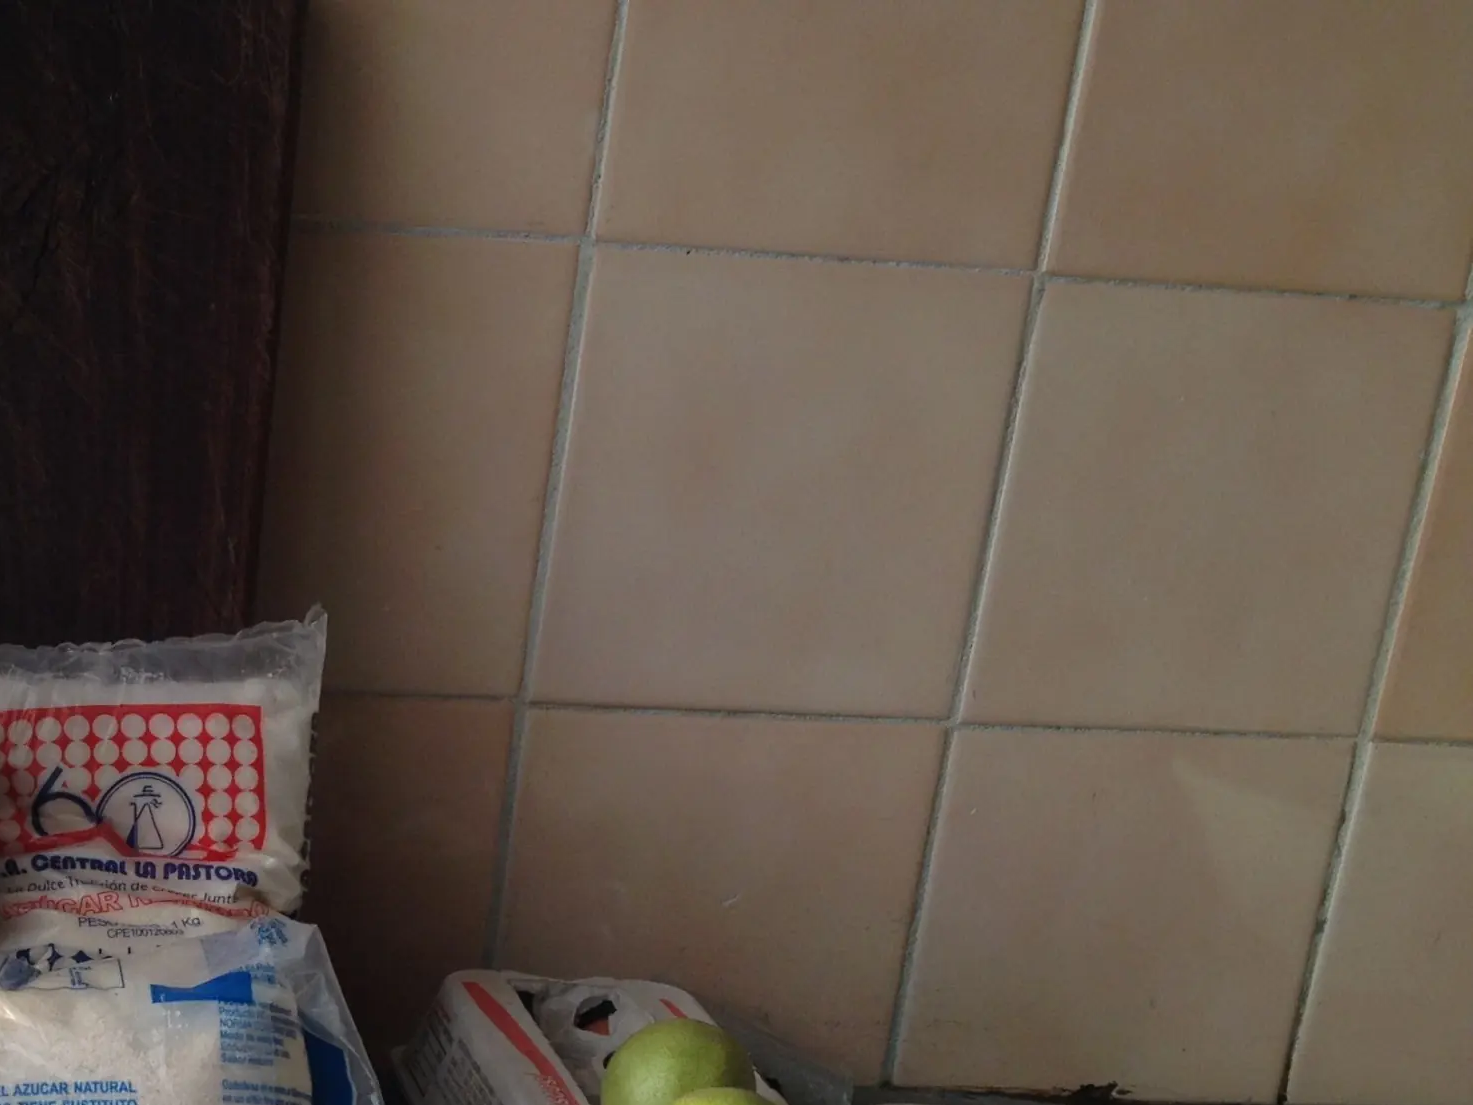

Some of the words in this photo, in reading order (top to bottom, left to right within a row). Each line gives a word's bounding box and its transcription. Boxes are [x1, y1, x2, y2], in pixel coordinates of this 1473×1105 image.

[31, 854, 127, 876] CENTRAL
[134, 860, 156, 880] LA
[162, 863, 259, 888] PASTORA
[131, 880, 149, 892] de
[13, 1082, 69, 1096] AZUCAR
[74, 1080, 137, 1093] NATURAL
